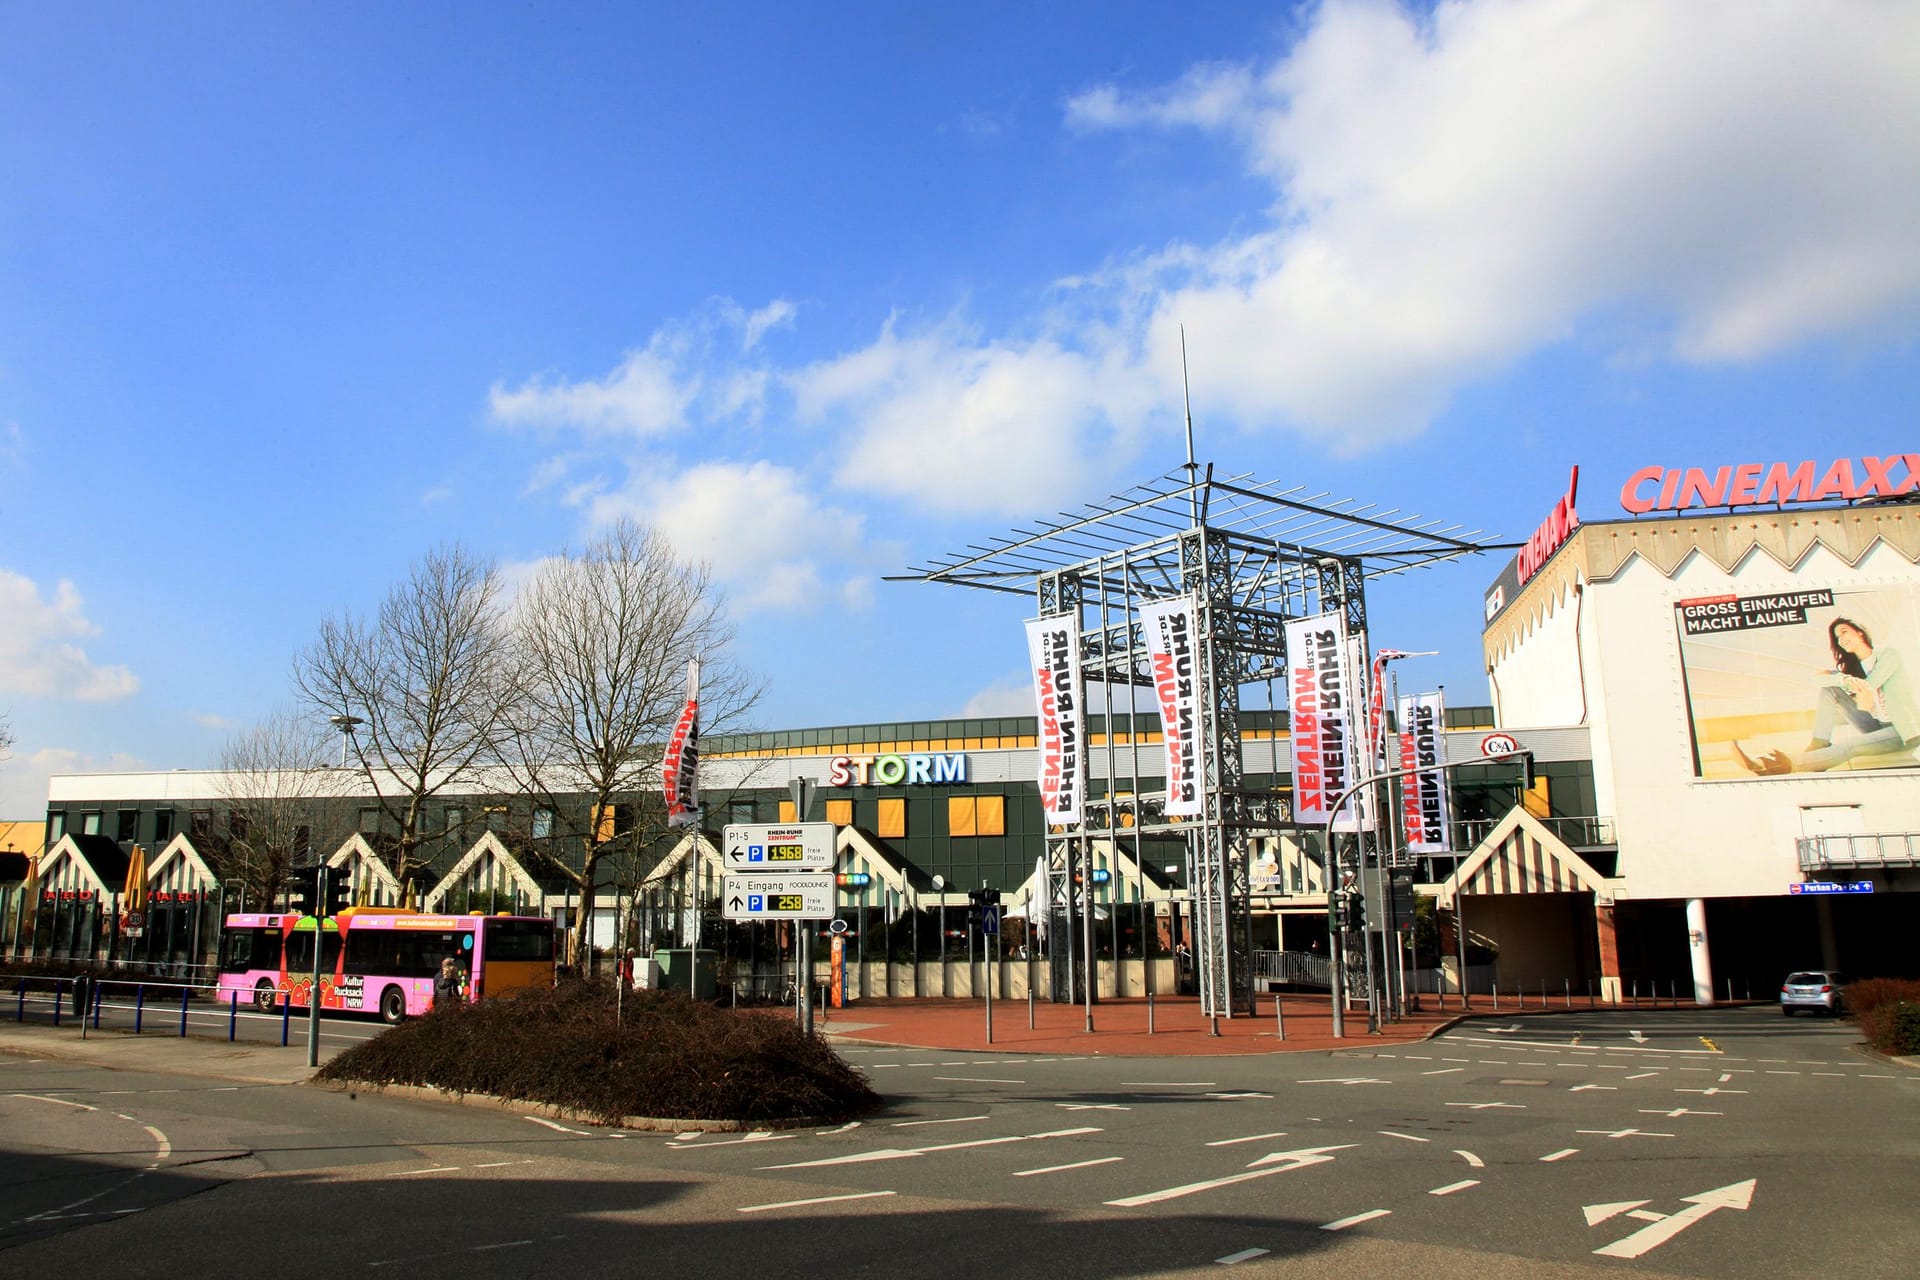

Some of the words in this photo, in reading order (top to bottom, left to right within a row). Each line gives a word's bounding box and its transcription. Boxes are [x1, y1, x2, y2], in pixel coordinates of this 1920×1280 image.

[1685, 602, 1737, 618] GROSS
[1741, 592, 1830, 612] EINKAUFEN
[1688, 616, 1741, 632] MACHT
[1746, 611, 1802, 626] LAUNE.
[1488, 741, 1511, 753] C&A
[830, 753, 967, 787] STORM
[729, 832, 749, 841] P1-5
[771, 846, 802, 860] 1968
[837, 873, 869, 884] TORM
[729, 881, 741, 890] P4
[747, 881, 784, 892] Eingang
[789, 881, 829, 889] FOODLOUNGE
[778, 896, 802, 910] 258
[129, 915, 141, 924] 30
[345, 975, 364, 986] Kultur
[334, 986, 363, 997] Rucksack
[347, 997, 363, 1008] NRW
